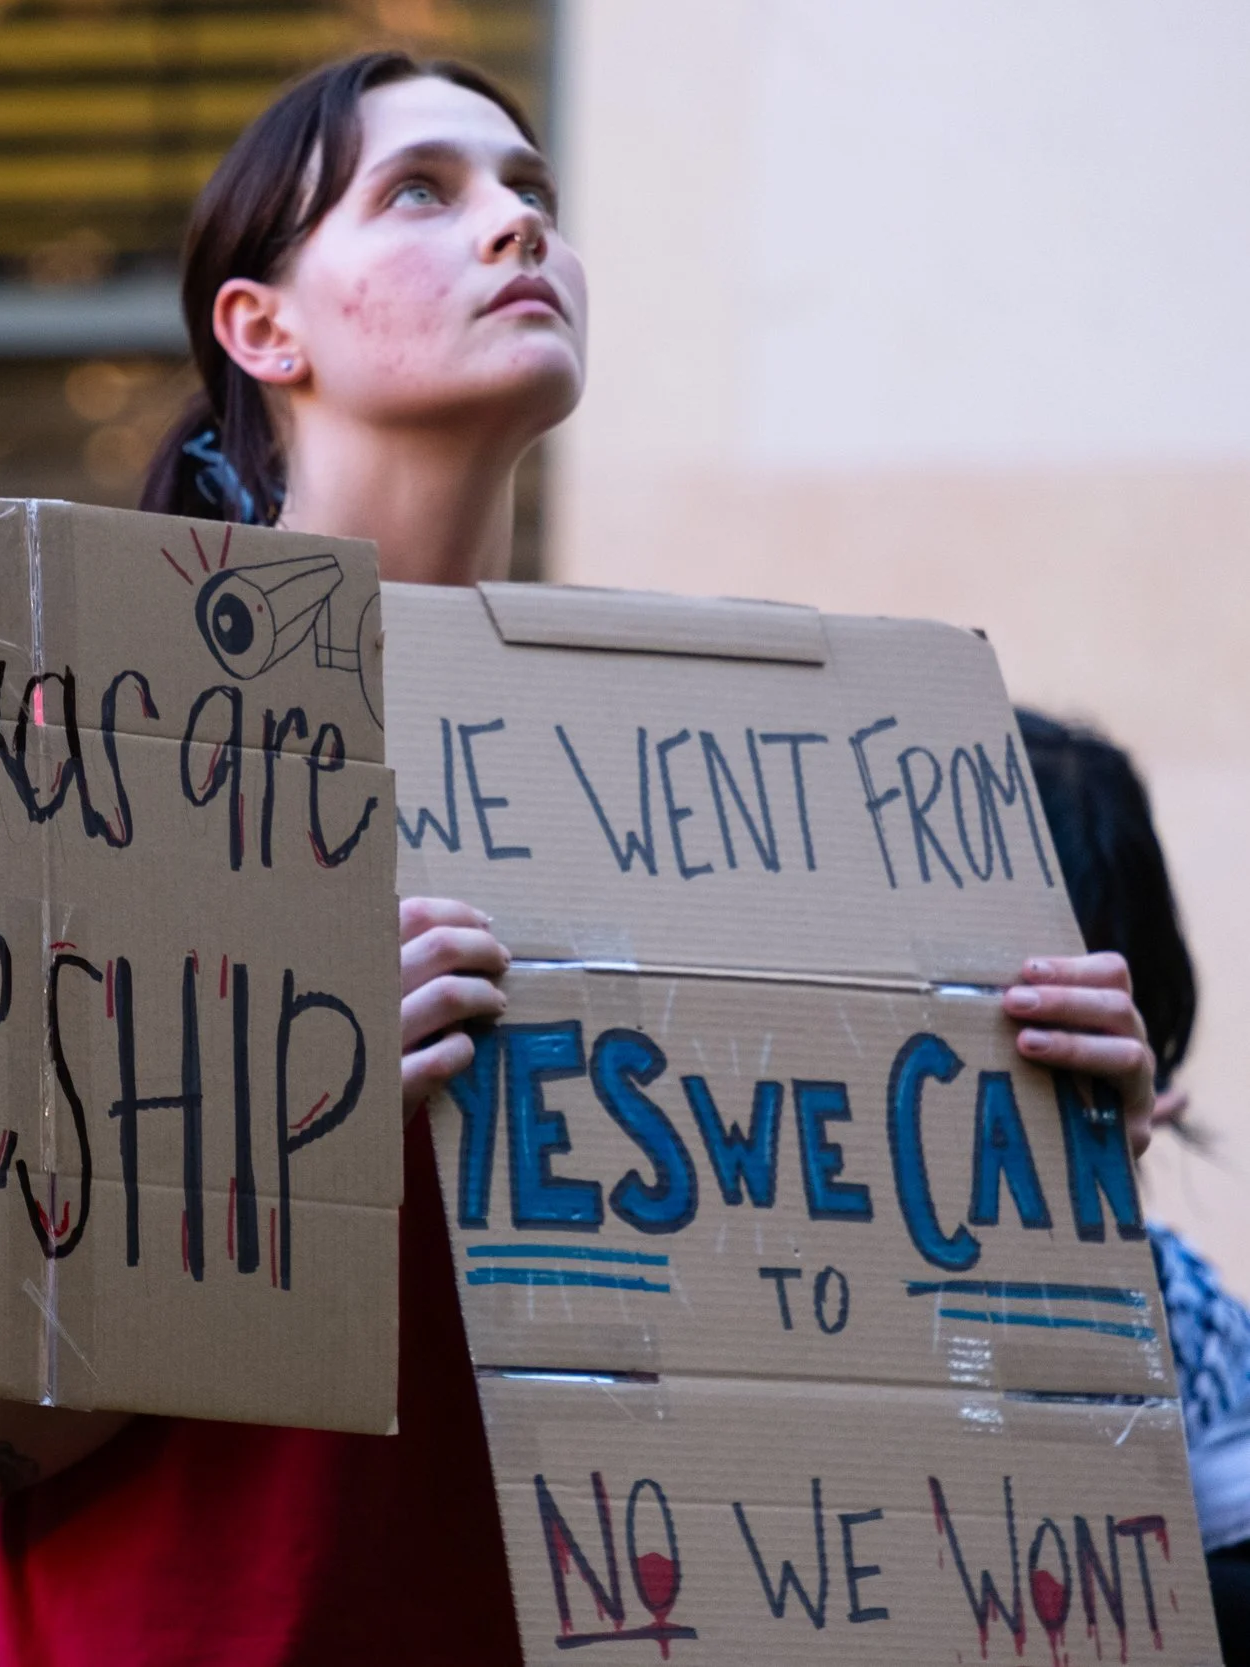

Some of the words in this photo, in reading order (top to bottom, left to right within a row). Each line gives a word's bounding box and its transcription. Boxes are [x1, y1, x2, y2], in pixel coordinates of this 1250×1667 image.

[180, 685, 379, 872] are
[396, 716, 533, 862] WE
[554, 724, 830, 882] WENT
[848, 715, 1057, 891] FROM
[444, 1018, 701, 1236] YES
[679, 1072, 874, 1222] WE
[886, 1030, 1150, 1272] CAN
[757, 1265, 851, 1335] TO
[533, 1470, 682, 1632] NO
[731, 1476, 892, 1632] WE
[926, 1474, 1172, 1655] WONT
